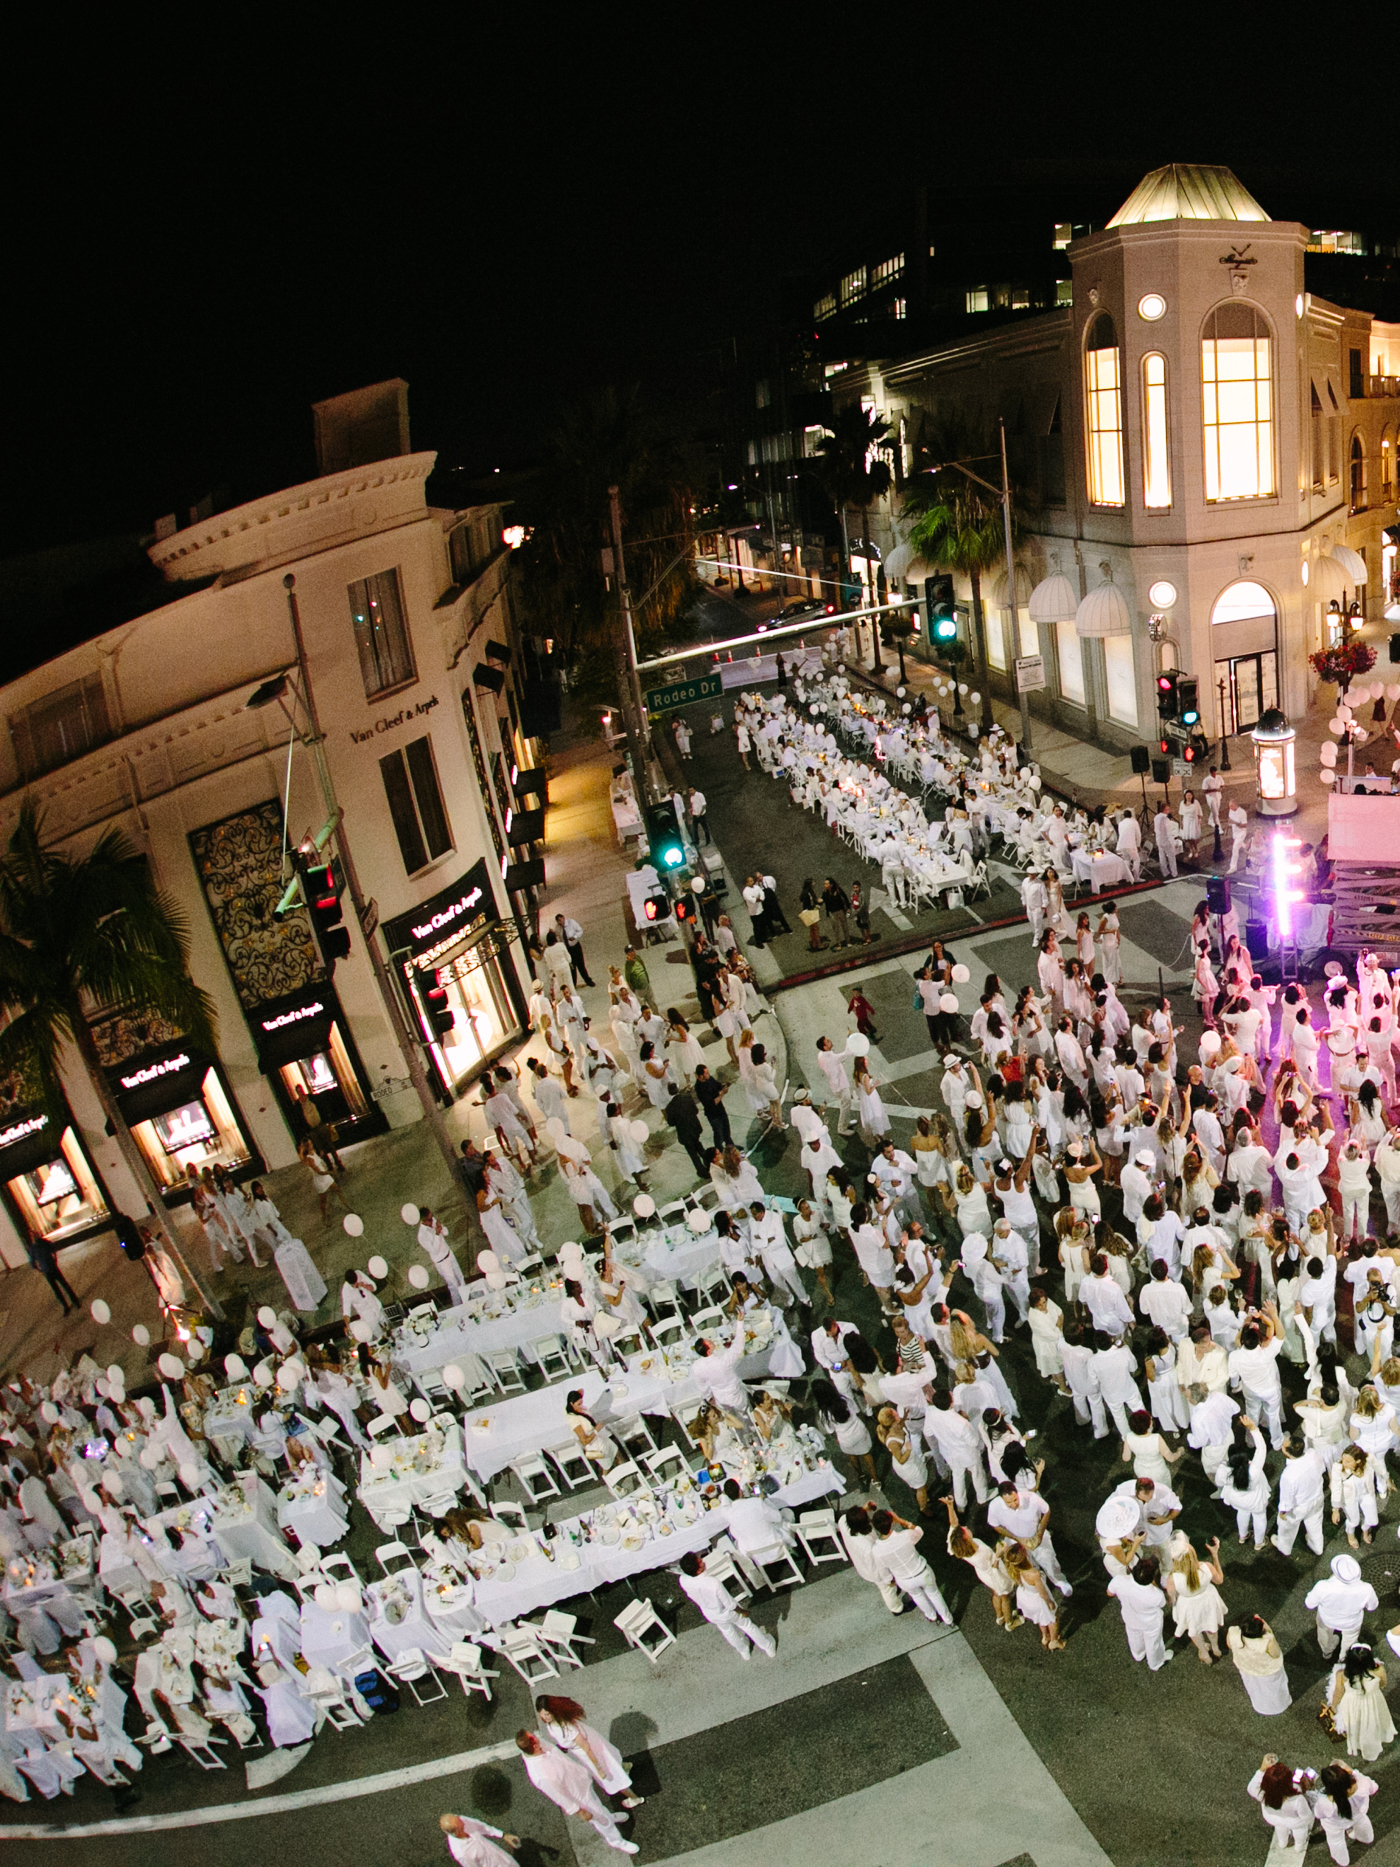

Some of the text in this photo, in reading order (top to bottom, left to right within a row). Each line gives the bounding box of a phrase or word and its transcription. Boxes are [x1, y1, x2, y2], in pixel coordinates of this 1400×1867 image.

[653, 682, 716, 707] Rodeo Dr
[350, 695, 439, 744] Van Cleef & Arpels
[411, 923, 433, 939] Van
[431, 905, 455, 929] Cleef
[461, 887, 482, 910] Arpels
[261, 1020, 279, 1031] Van
[275, 1011, 296, 1026] Cleef
[120, 1076, 140, 1089] Van
[135, 1064, 158, 1083] Cleef
[373, 1087, 392, 1099] RODEO
